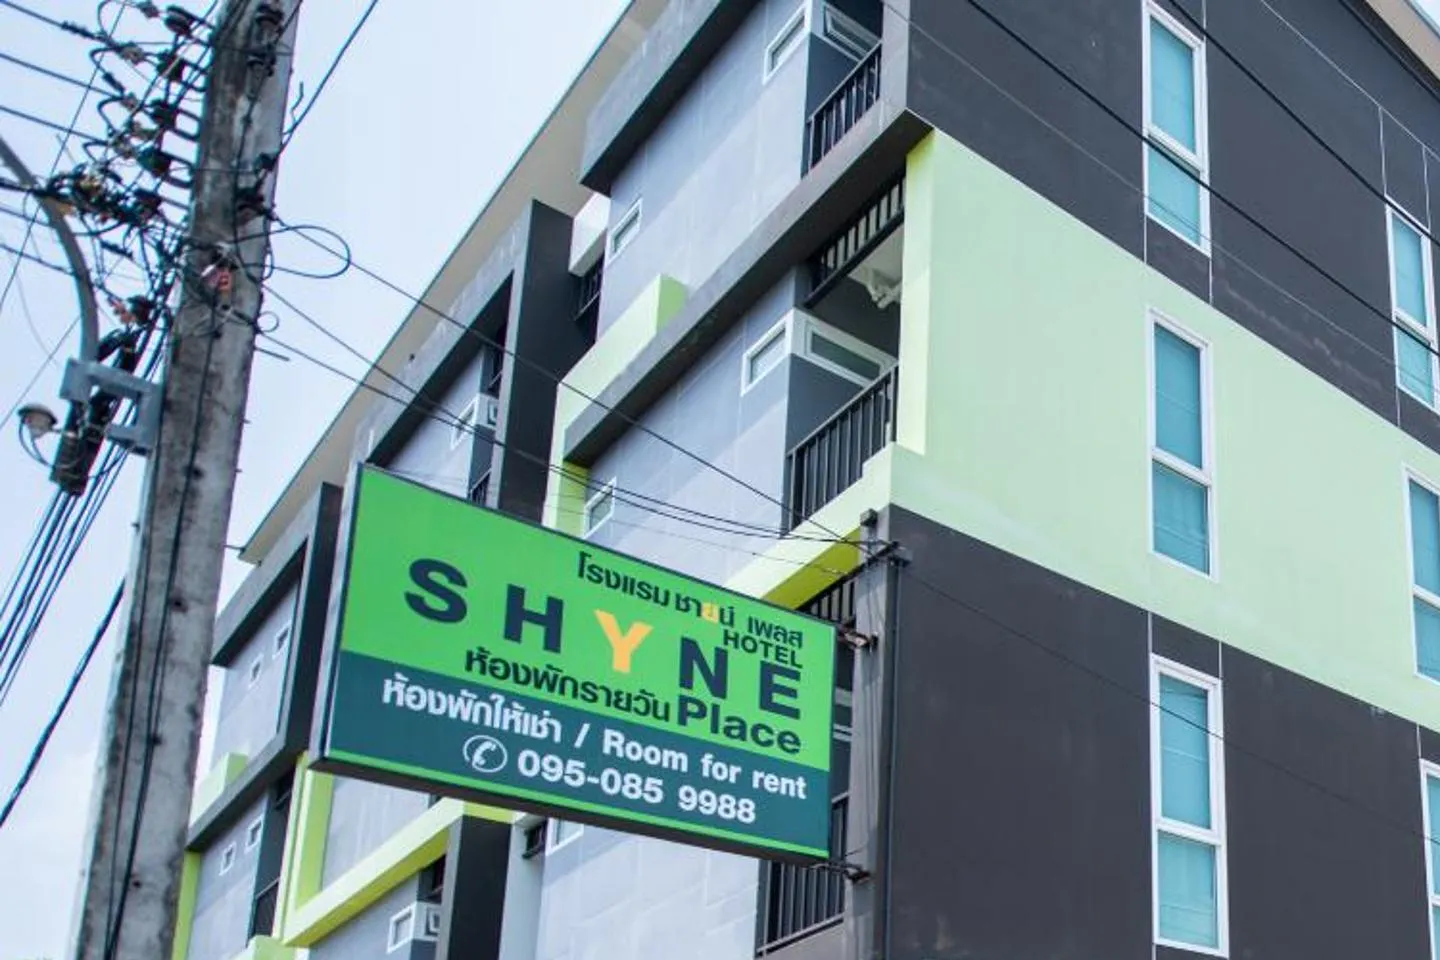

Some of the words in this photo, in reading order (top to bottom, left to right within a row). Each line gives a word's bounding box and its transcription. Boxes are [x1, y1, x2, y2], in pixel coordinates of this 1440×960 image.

[403, 557, 800, 720] SHYNE
[577, 551, 670, 607] โรงแรม
[747, 616, 804, 649] เพลส
[464, 646, 670, 723] ห้องพักรายวัน
[722, 629, 804, 669] HOTEL
[382, 671, 562, 743] ห้องพักให้เช่า
[602, 728, 689, 773] Room
[700, 754, 742, 783] for
[751, 769, 807, 800] rent
[676, 694, 802, 755] Place
[517, 749, 664, 804] 095-085
[678, 785, 756, 824] 9988
